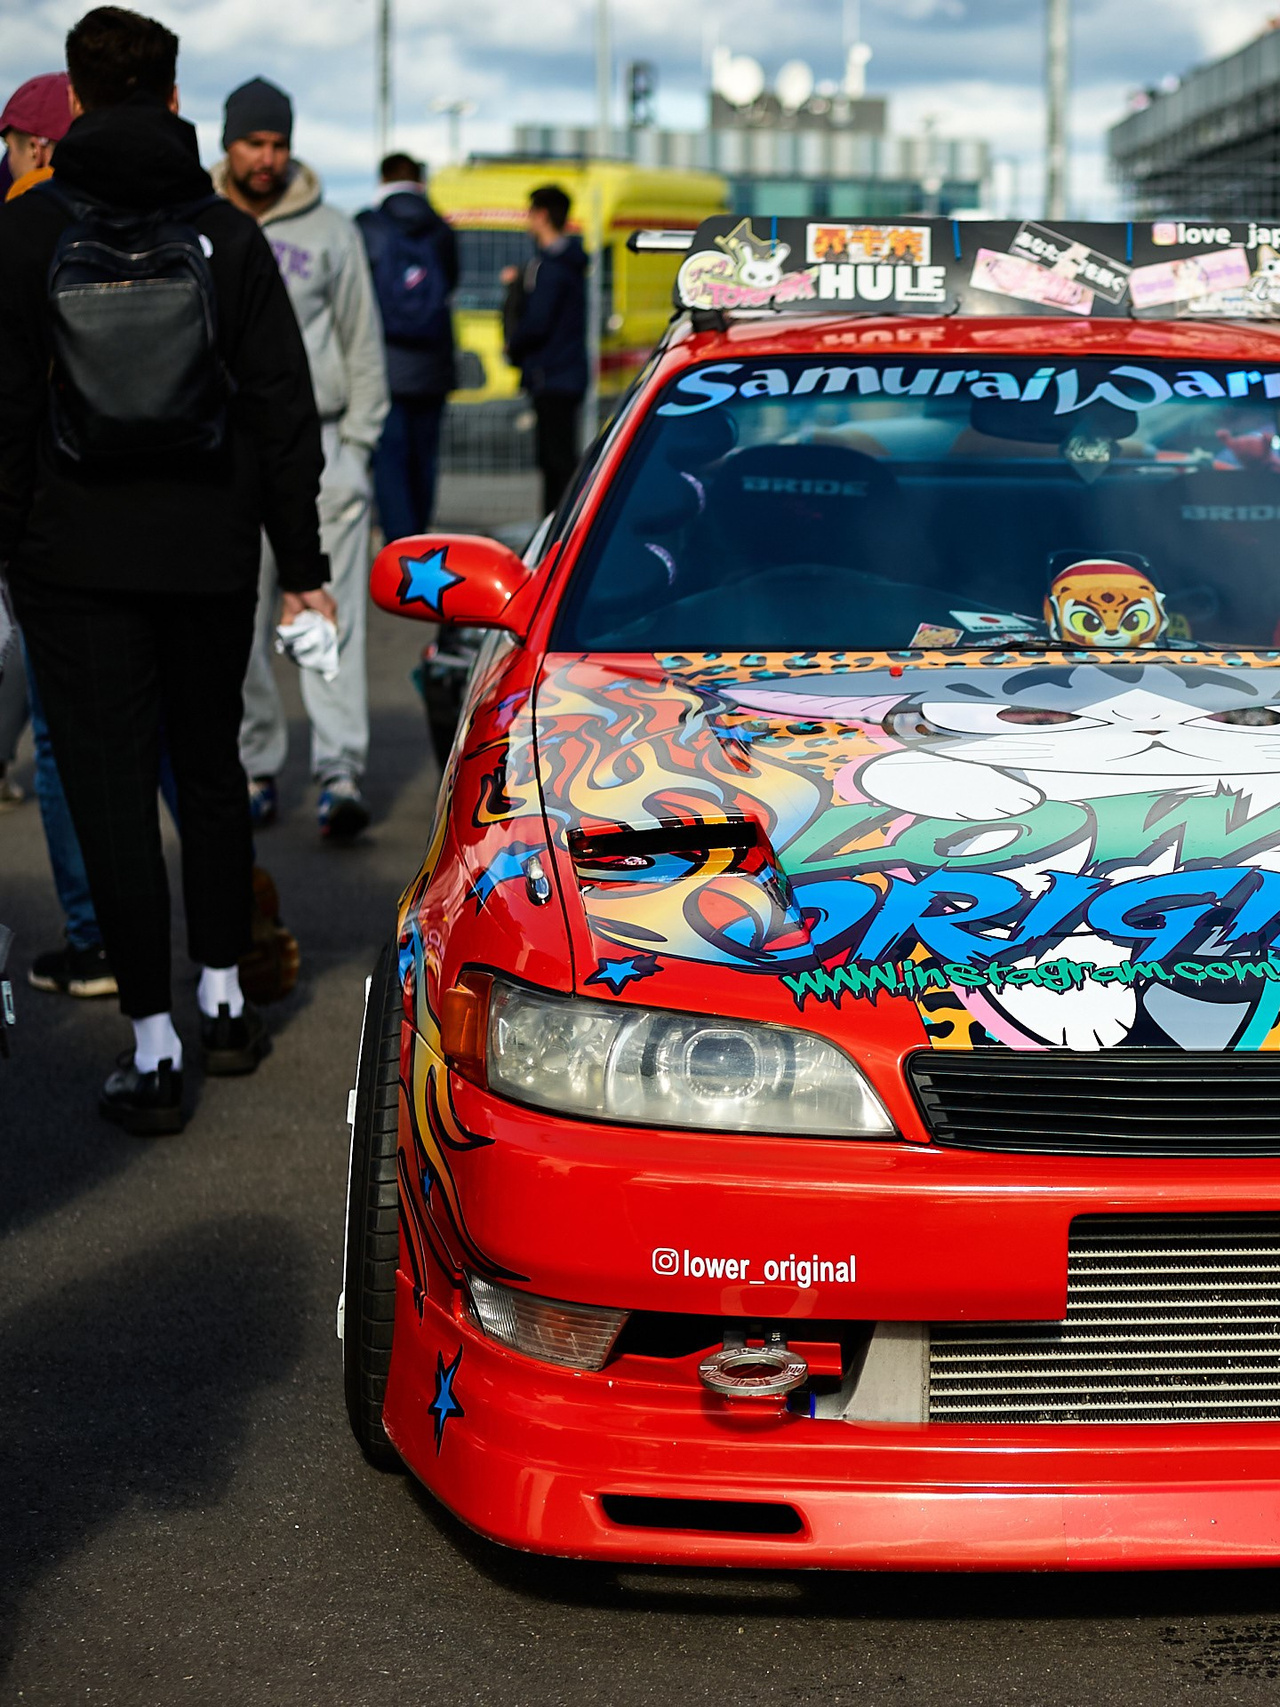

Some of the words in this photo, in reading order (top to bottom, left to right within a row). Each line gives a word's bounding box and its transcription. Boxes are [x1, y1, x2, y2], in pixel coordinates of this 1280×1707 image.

[819, 263, 946, 302] HULE
[742, 475, 868, 498] BRIDE
[683, 1249, 856, 1289] lower_original
